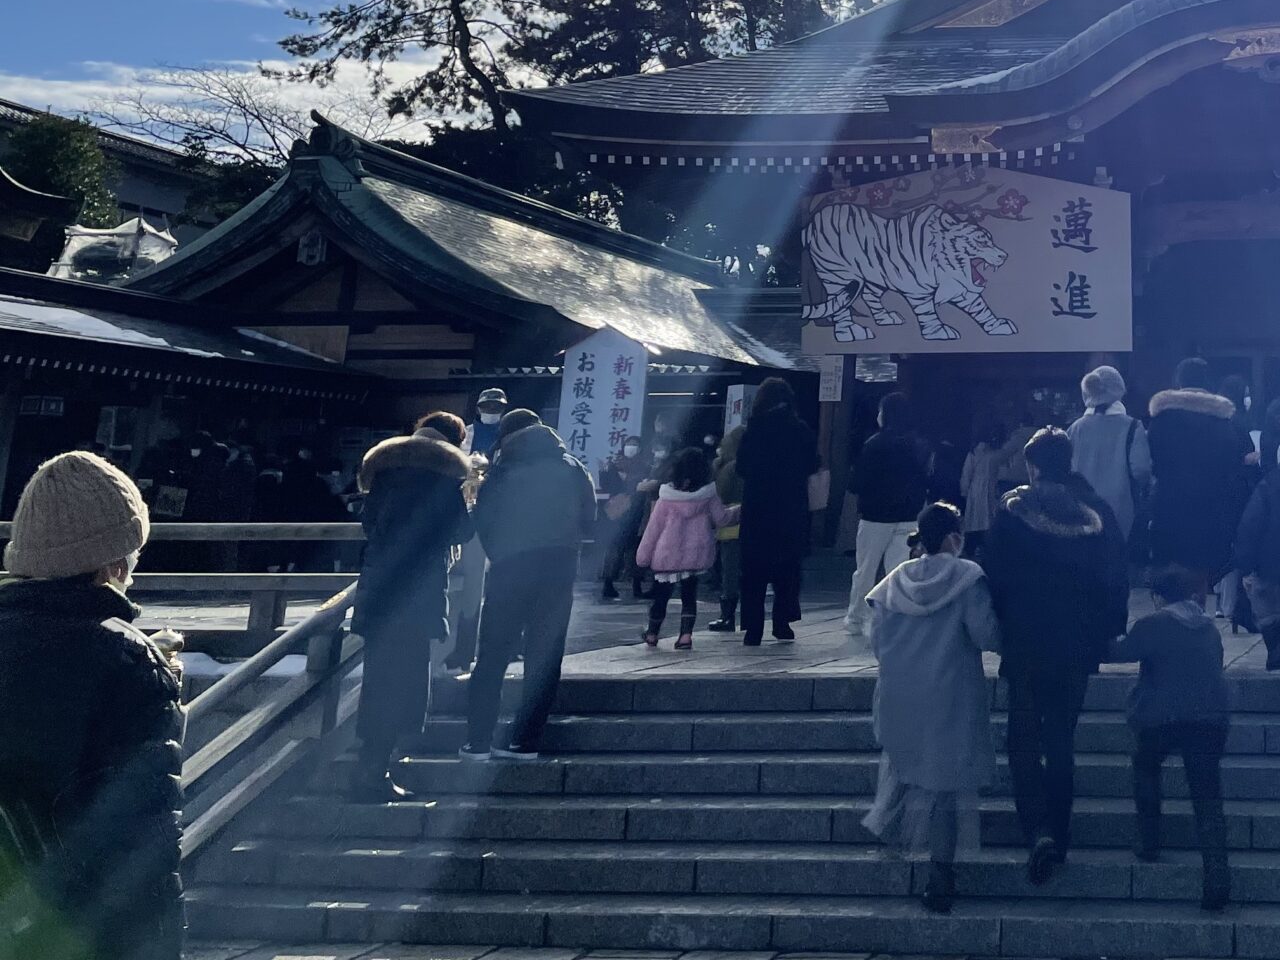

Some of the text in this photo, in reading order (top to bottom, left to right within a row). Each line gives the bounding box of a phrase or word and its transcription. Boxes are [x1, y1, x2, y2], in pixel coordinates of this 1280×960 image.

[1050, 197, 1099, 319] 邁進
[568, 352, 596, 465] お祓受付
